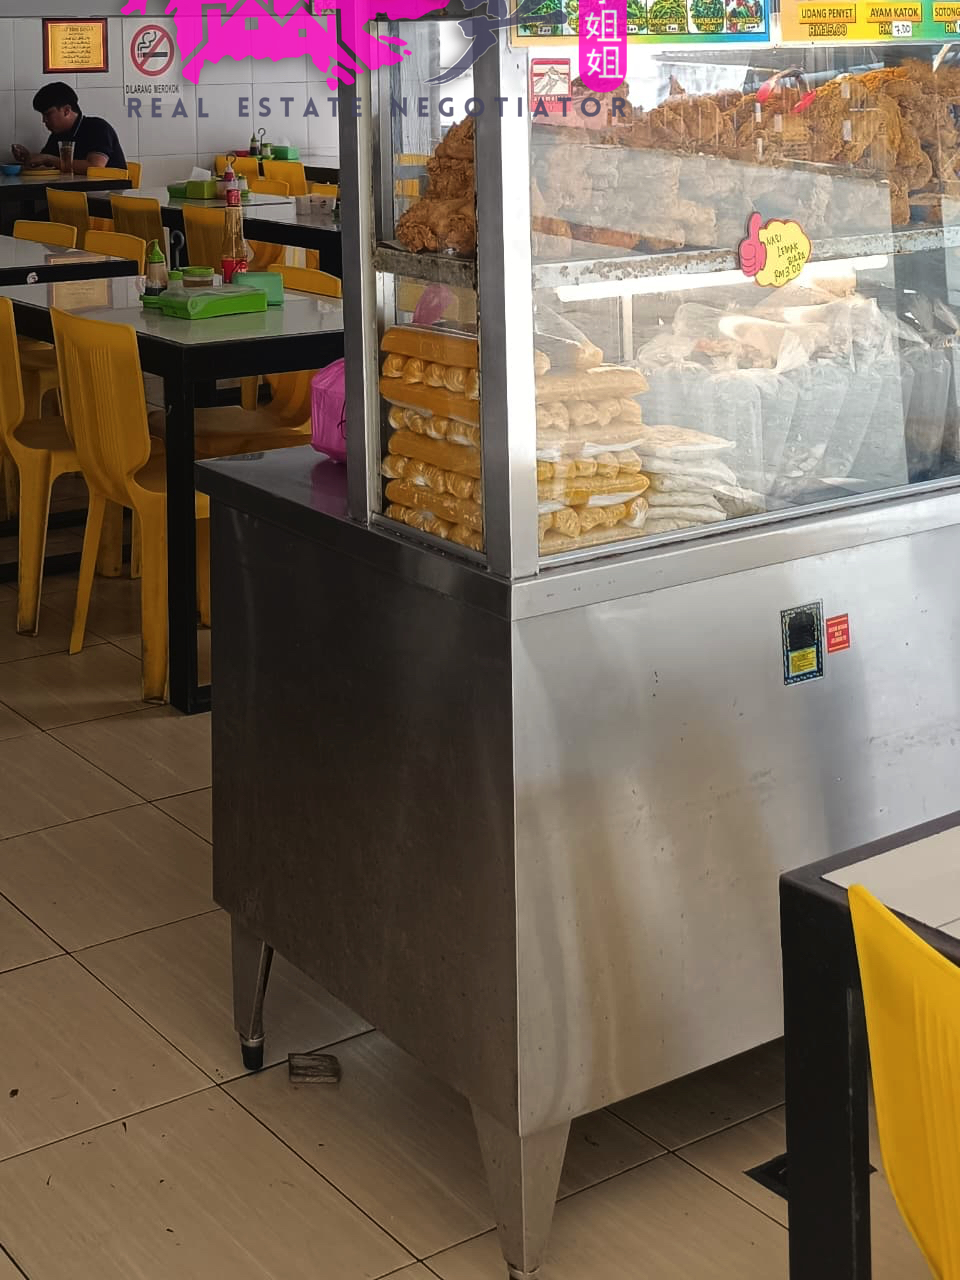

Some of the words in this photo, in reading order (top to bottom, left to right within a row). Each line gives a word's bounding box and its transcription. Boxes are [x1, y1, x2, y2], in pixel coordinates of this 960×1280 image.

[801, 8, 827, 19] UDANG
[827, 8, 853, 19] PENYET
[870, 7, 893, 18] AYAM
[893, 7, 919, 18] KATOK
[125, 84, 152, 94] DILARANG
